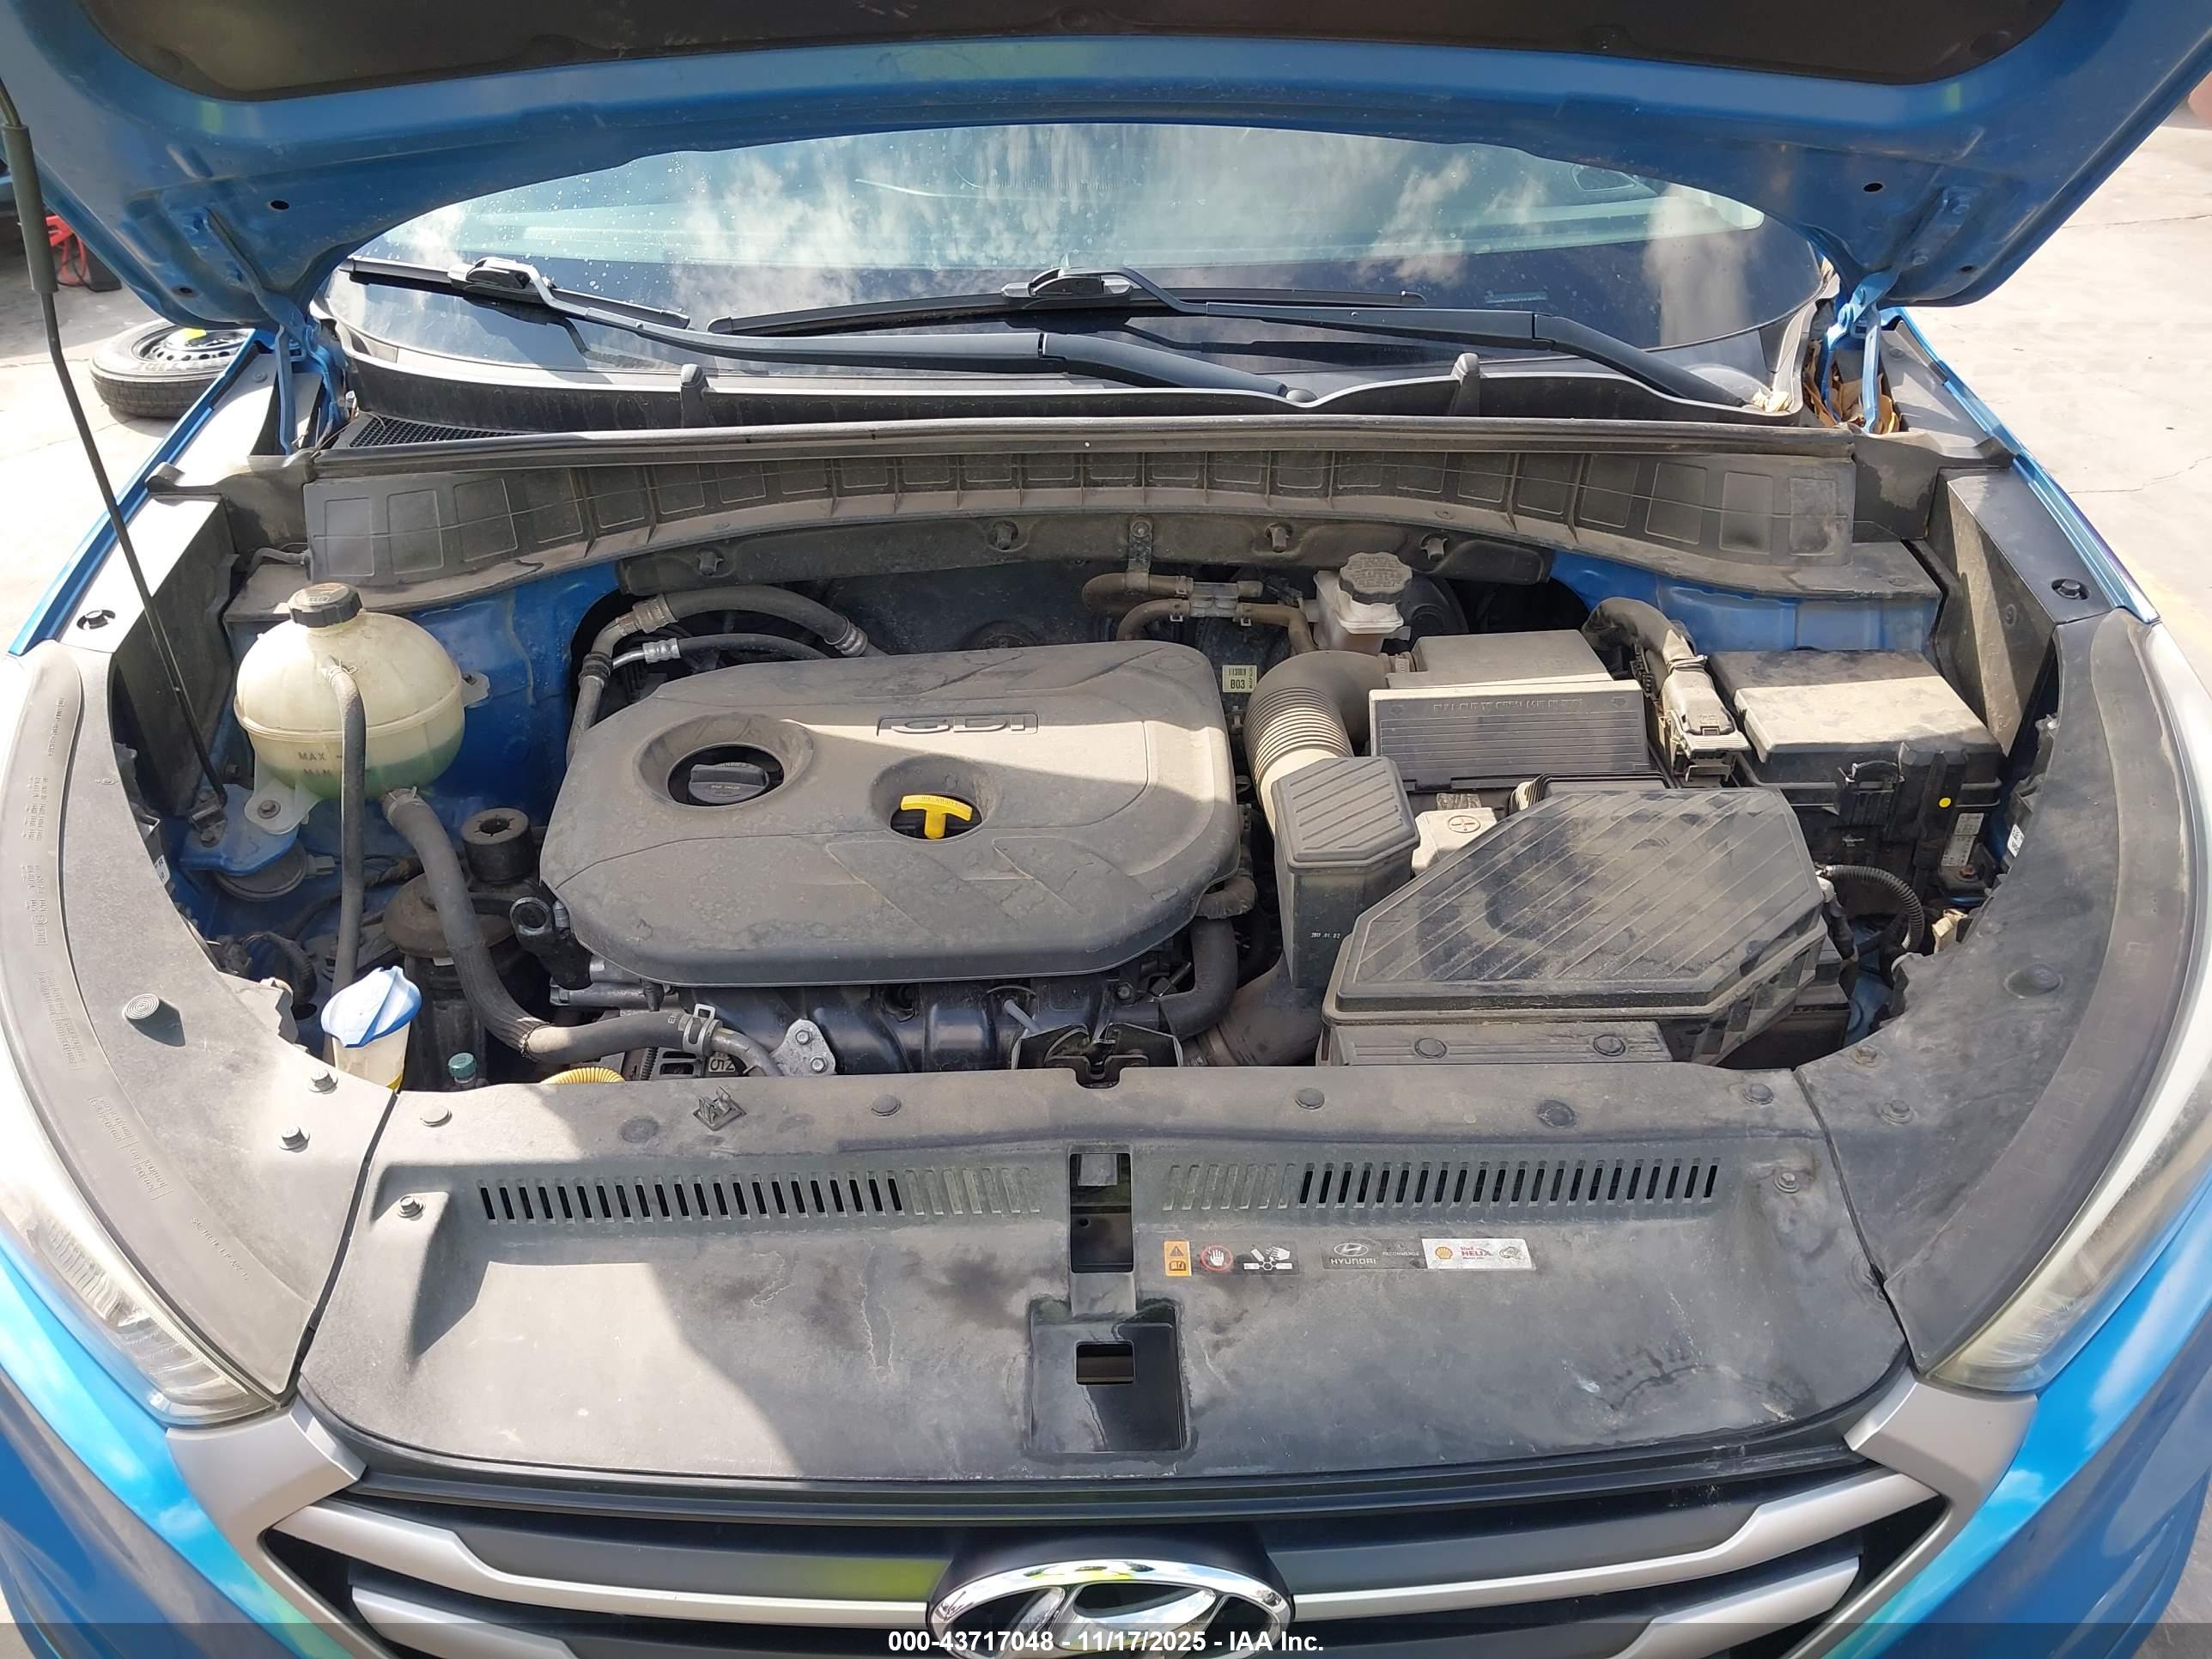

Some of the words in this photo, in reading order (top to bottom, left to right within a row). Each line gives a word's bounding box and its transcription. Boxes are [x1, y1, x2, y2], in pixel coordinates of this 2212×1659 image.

[1231, 679, 1245, 690] B03
[890, 714, 1025, 734] GDI
[297, 751, 327, 761] MAX
